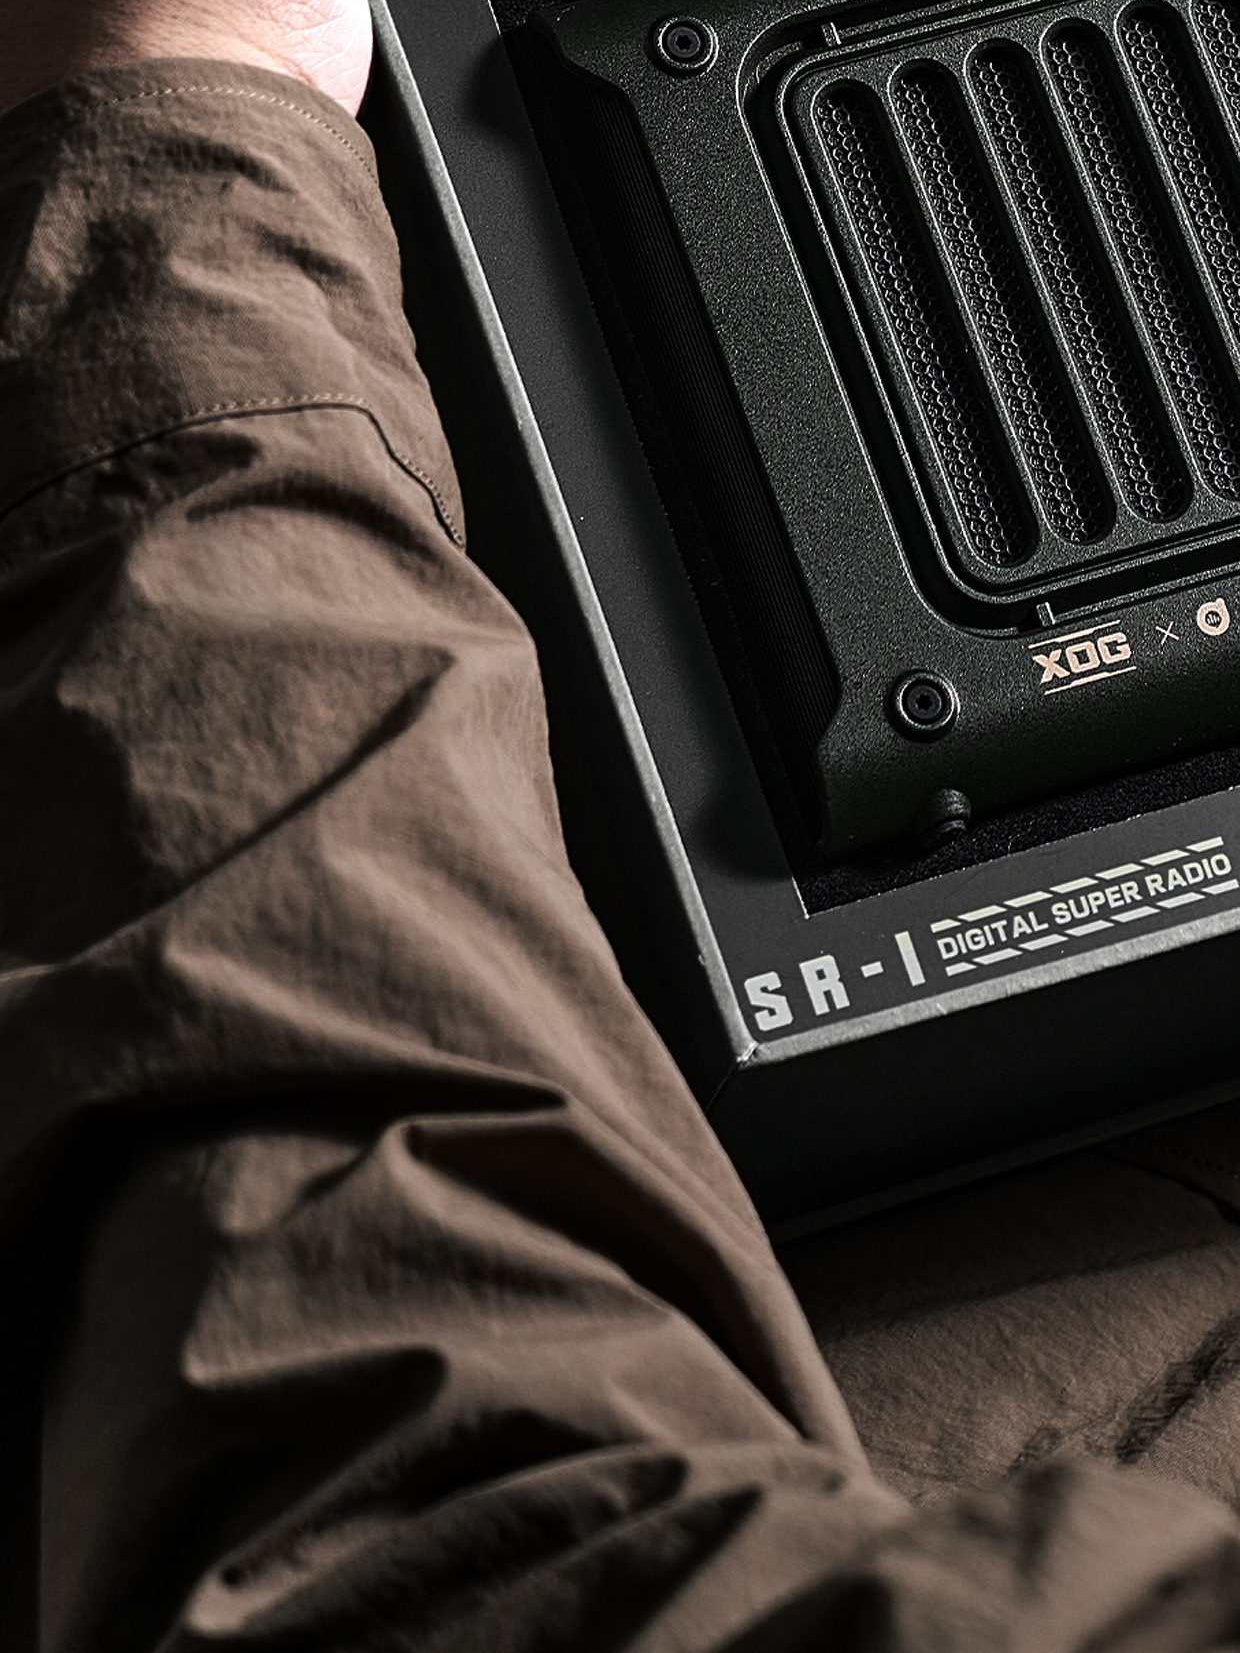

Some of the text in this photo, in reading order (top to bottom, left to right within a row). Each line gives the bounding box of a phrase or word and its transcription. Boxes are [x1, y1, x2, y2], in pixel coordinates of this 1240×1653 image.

[1031, 631, 1132, 685] XOG
[936, 852, 1233, 961] DIGITAL SUPER RADIO
